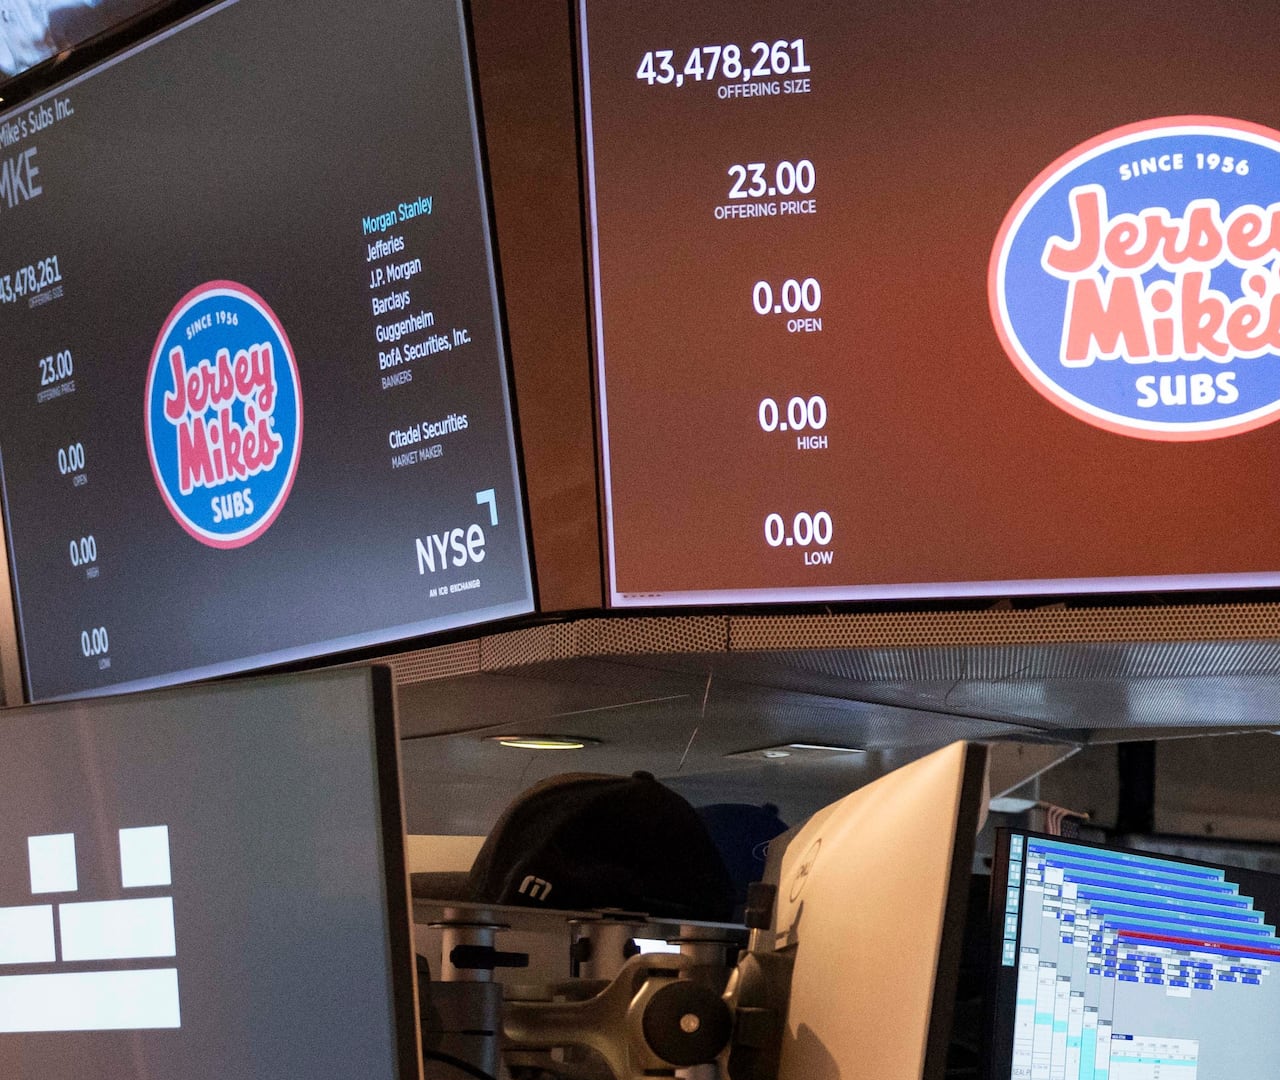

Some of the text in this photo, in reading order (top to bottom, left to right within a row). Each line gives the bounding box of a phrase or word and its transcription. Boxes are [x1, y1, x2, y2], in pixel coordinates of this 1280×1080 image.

[636, 38, 810, 88] 43,478,261
[717, 78, 811, 100] OFFERING SIZE
[28, 106, 53, 134] Subs
[54, 98, 74, 121] Inc.
[727, 159, 816, 199] 23.00
[1119, 153, 1250, 181] SINCE 1956
[362, 195, 434, 237] Morgan Stanley
[714, 200, 817, 220] OFFERING PRICE
[366, 235, 405, 262] Jefferies
[370, 257, 422, 289] J.P. Morgan
[372, 289, 411, 316] Barclays
[753, 277, 822, 315] 0.00
[185, 311, 239, 340] SINCE 1956
[376, 310, 435, 343] Guggenheim
[786, 318, 823, 333] OPEN
[378, 327, 472, 371] BofA Securities, Inc.
[39, 349, 73, 387] 23.00
[164, 343, 277, 423] Jersey
[381, 370, 413, 390] BANKERS
[1135, 371, 1240, 408] SUBS
[758, 395, 828, 432] 0.00
[389, 413, 469, 449] Citadel Securities
[797, 435, 828, 450] HIGH
[58, 442, 85, 475] 0.00
[178, 405, 281, 492] Mike's
[391, 444, 443, 469] MARKET MAKER
[210, 488, 254, 523] SUBS
[764, 511, 833, 547] 0.00
[69, 535, 97, 567] 0.00
[804, 551, 834, 566] LOW
[81, 626, 109, 657] 0.00
